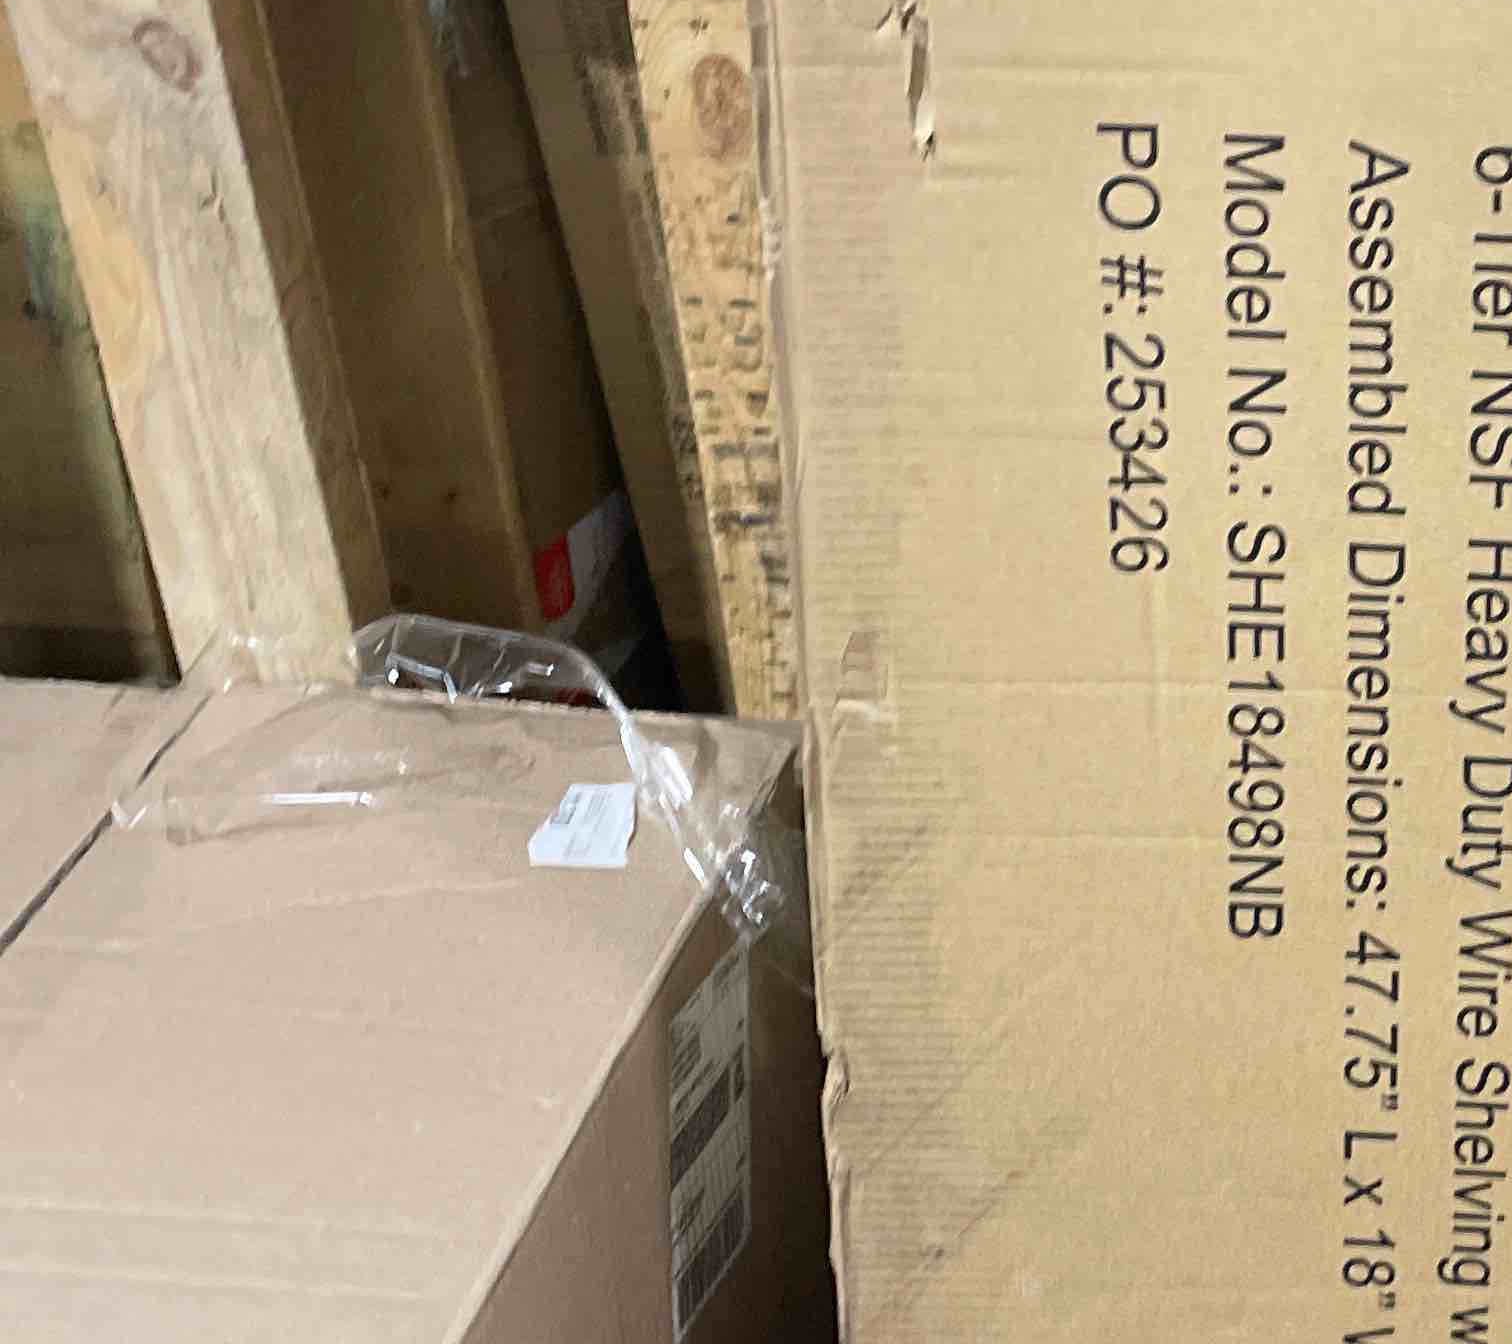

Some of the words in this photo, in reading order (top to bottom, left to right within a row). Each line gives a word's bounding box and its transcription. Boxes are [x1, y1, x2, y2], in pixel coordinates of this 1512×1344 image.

[1094, 121, 1163, 232] PO
[1222, 132, 1289, 342] Model
[1098, 253, 1166, 317] #:
[1345, 138, 1412, 518] Assembled
[1102, 331, 1171, 574] 253426
[1225, 366, 1290, 498] No.:
[1225, 519, 1288, 942] SHE18498NB
[1342, 540, 1408, 913] Dimensions:
[1342, 1128, 1400, 1162] L
[1342, 1174, 1385, 1208] x
[1435, 1056, 1512, 1289] Shelving
